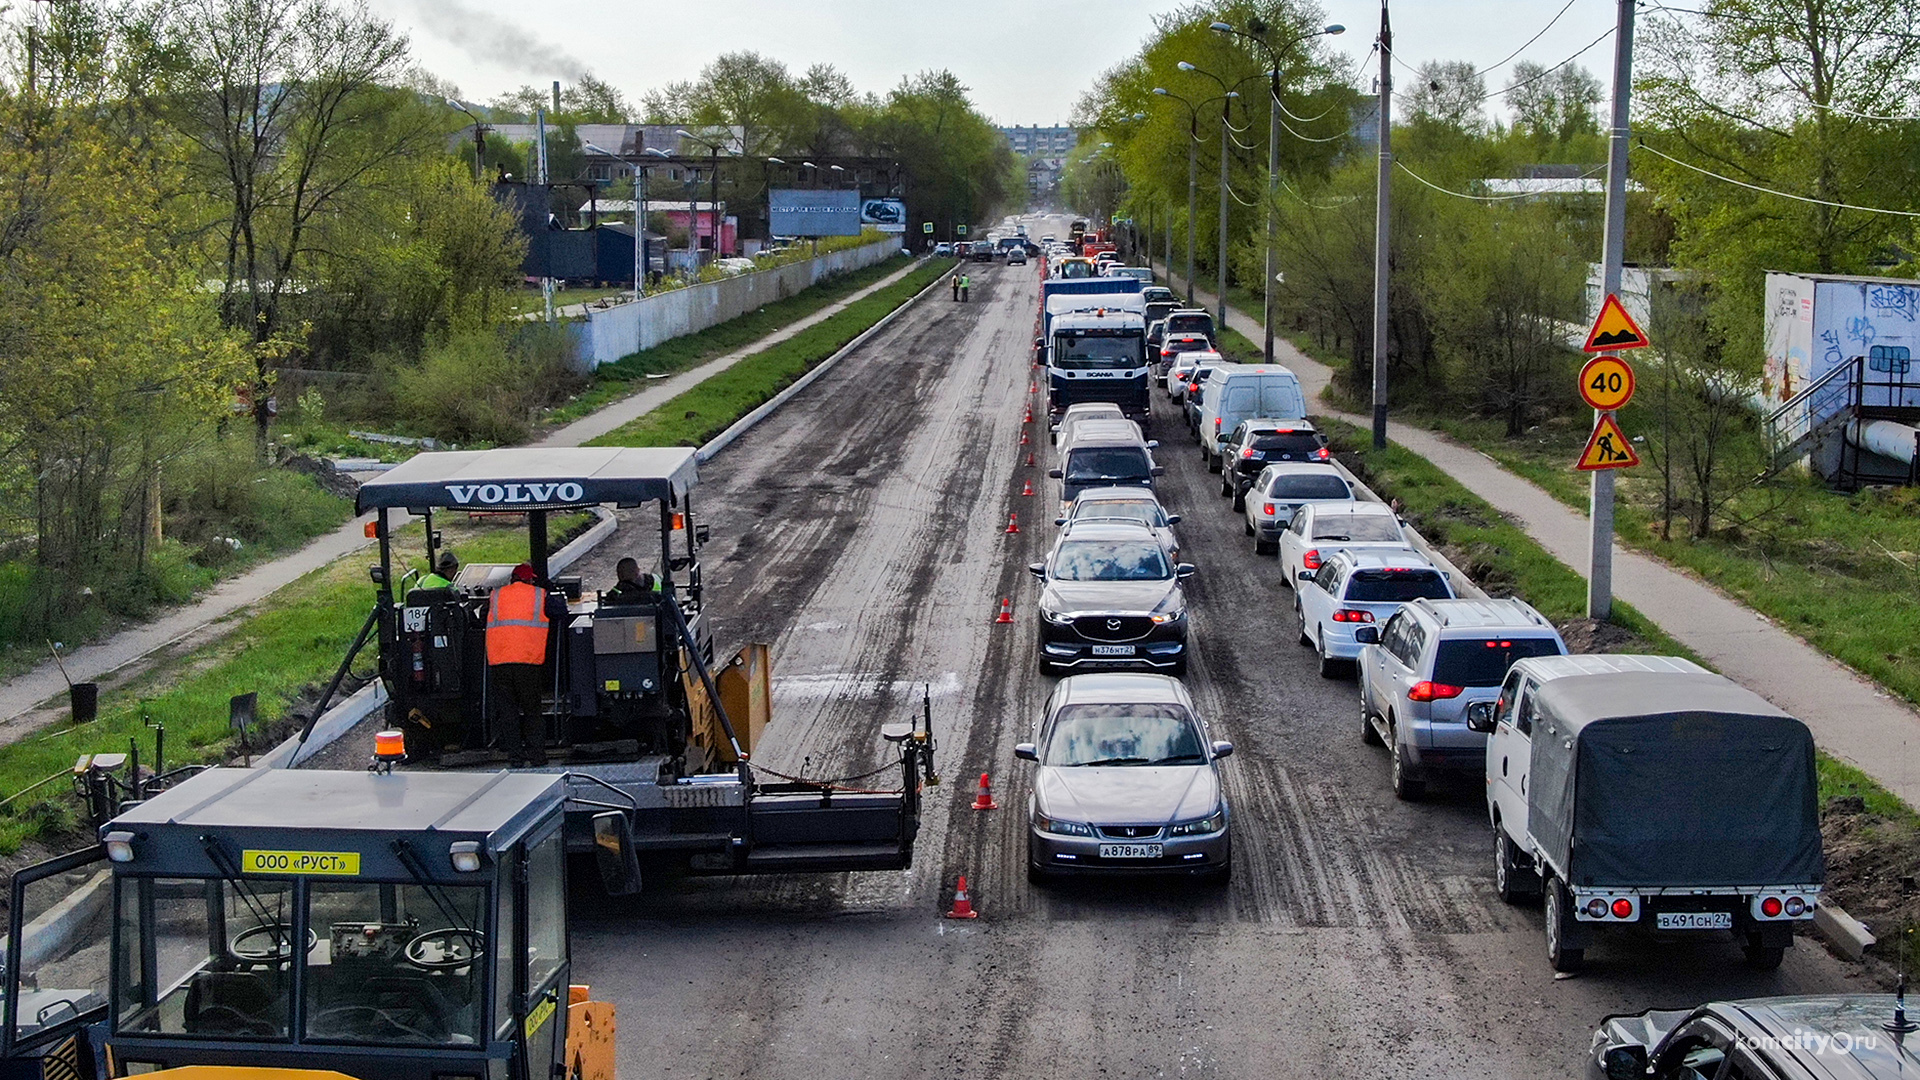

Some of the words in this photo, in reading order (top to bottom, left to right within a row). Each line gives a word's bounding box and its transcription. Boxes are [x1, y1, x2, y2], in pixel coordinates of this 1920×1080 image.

[1591, 372, 1622, 393] 40
[445, 482, 584, 504] VOLVO
[255, 854, 289, 869] ООО
[293, 855, 346, 870] «РУСТ»
